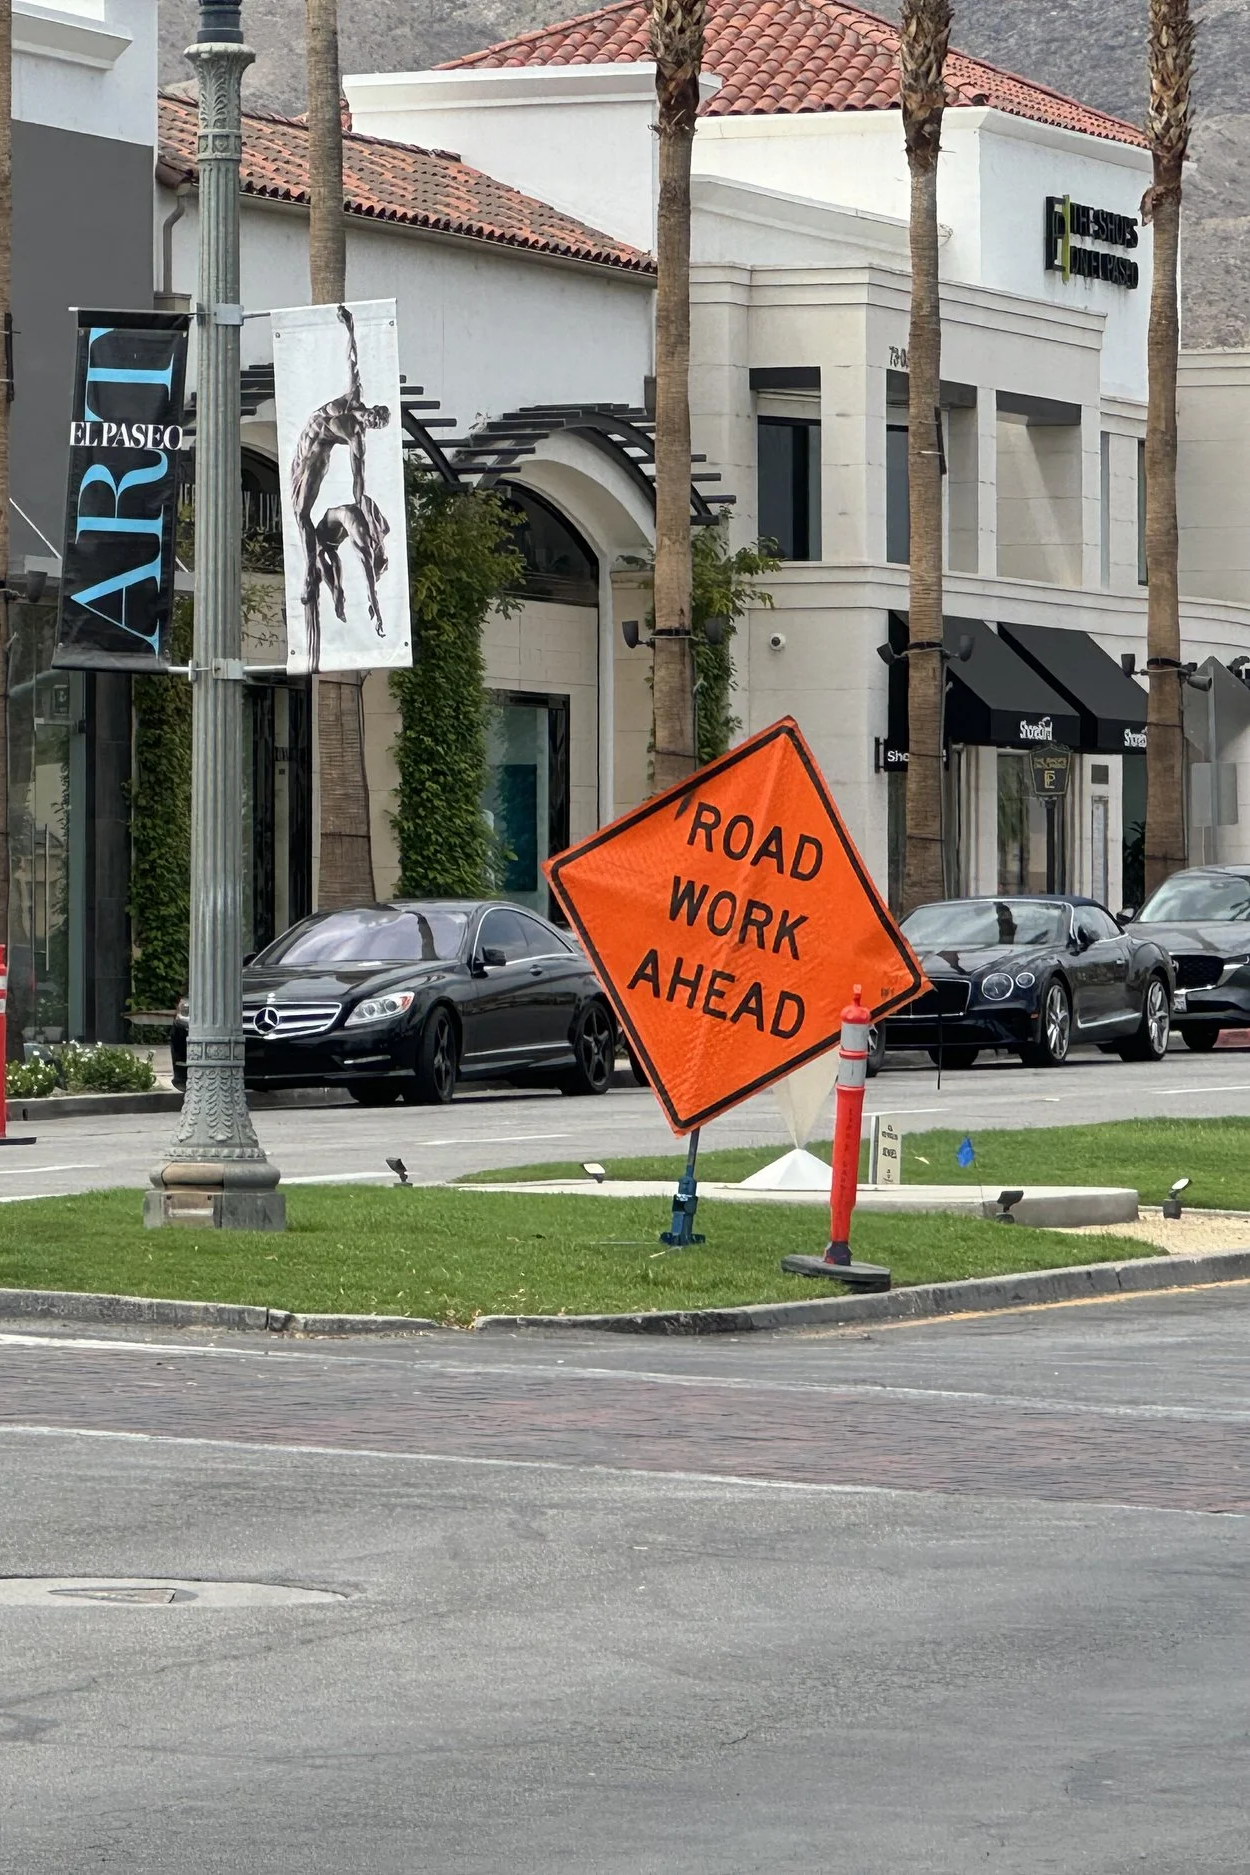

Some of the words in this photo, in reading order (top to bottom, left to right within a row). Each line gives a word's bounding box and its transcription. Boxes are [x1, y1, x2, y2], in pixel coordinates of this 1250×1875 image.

[69, 421, 100, 447] EL
[101, 422, 183, 450] PASEO
[70, 327, 175, 660] ART
[687, 801, 823, 881] ROAD
[669, 875, 809, 961] WORK
[626, 948, 805, 1039] AHEAD
